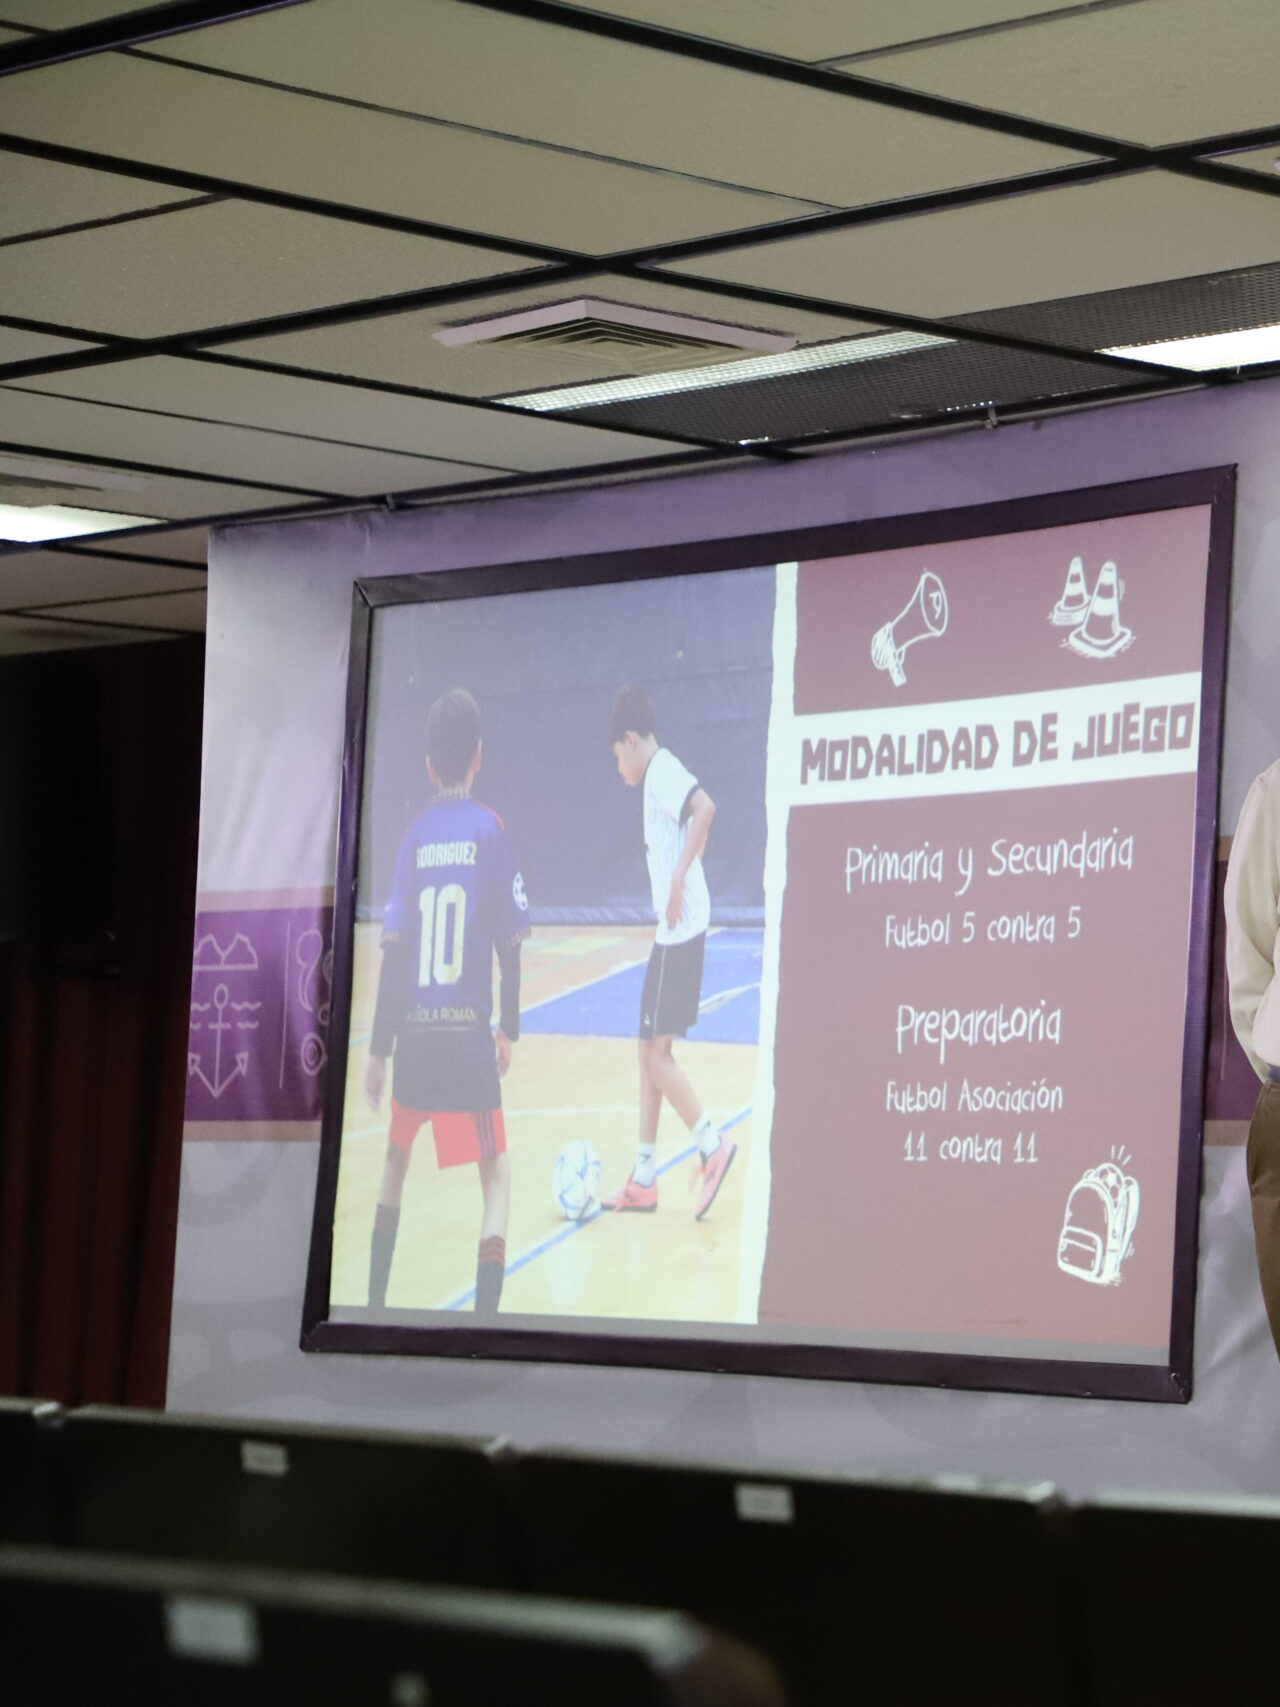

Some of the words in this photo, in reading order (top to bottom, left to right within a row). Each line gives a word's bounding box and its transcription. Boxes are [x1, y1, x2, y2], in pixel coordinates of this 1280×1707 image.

[800, 724, 1000, 785] MODALIDAD
[1012, 712, 1058, 767] DE
[1072, 702, 1196, 761] JUEGO
[845, 842, 944, 893] Primaria
[955, 846, 974, 896] y
[987, 828, 1135, 878] Secundaria
[418, 883, 467, 988] 10
[885, 913, 950, 948] Futbol
[962, 911, 976, 943] 5
[987, 909, 1056, 943] contra
[1067, 906, 1082, 938] 5
[895, 999, 1062, 1064] Preparatoria
[886, 1080, 947, 1113] Futbol
[957, 1078, 1064, 1112] Asociación
[904, 1132, 927, 1161] 11
[939, 1133, 1001, 1164] contra
[1014, 1132, 1038, 1163] 11
